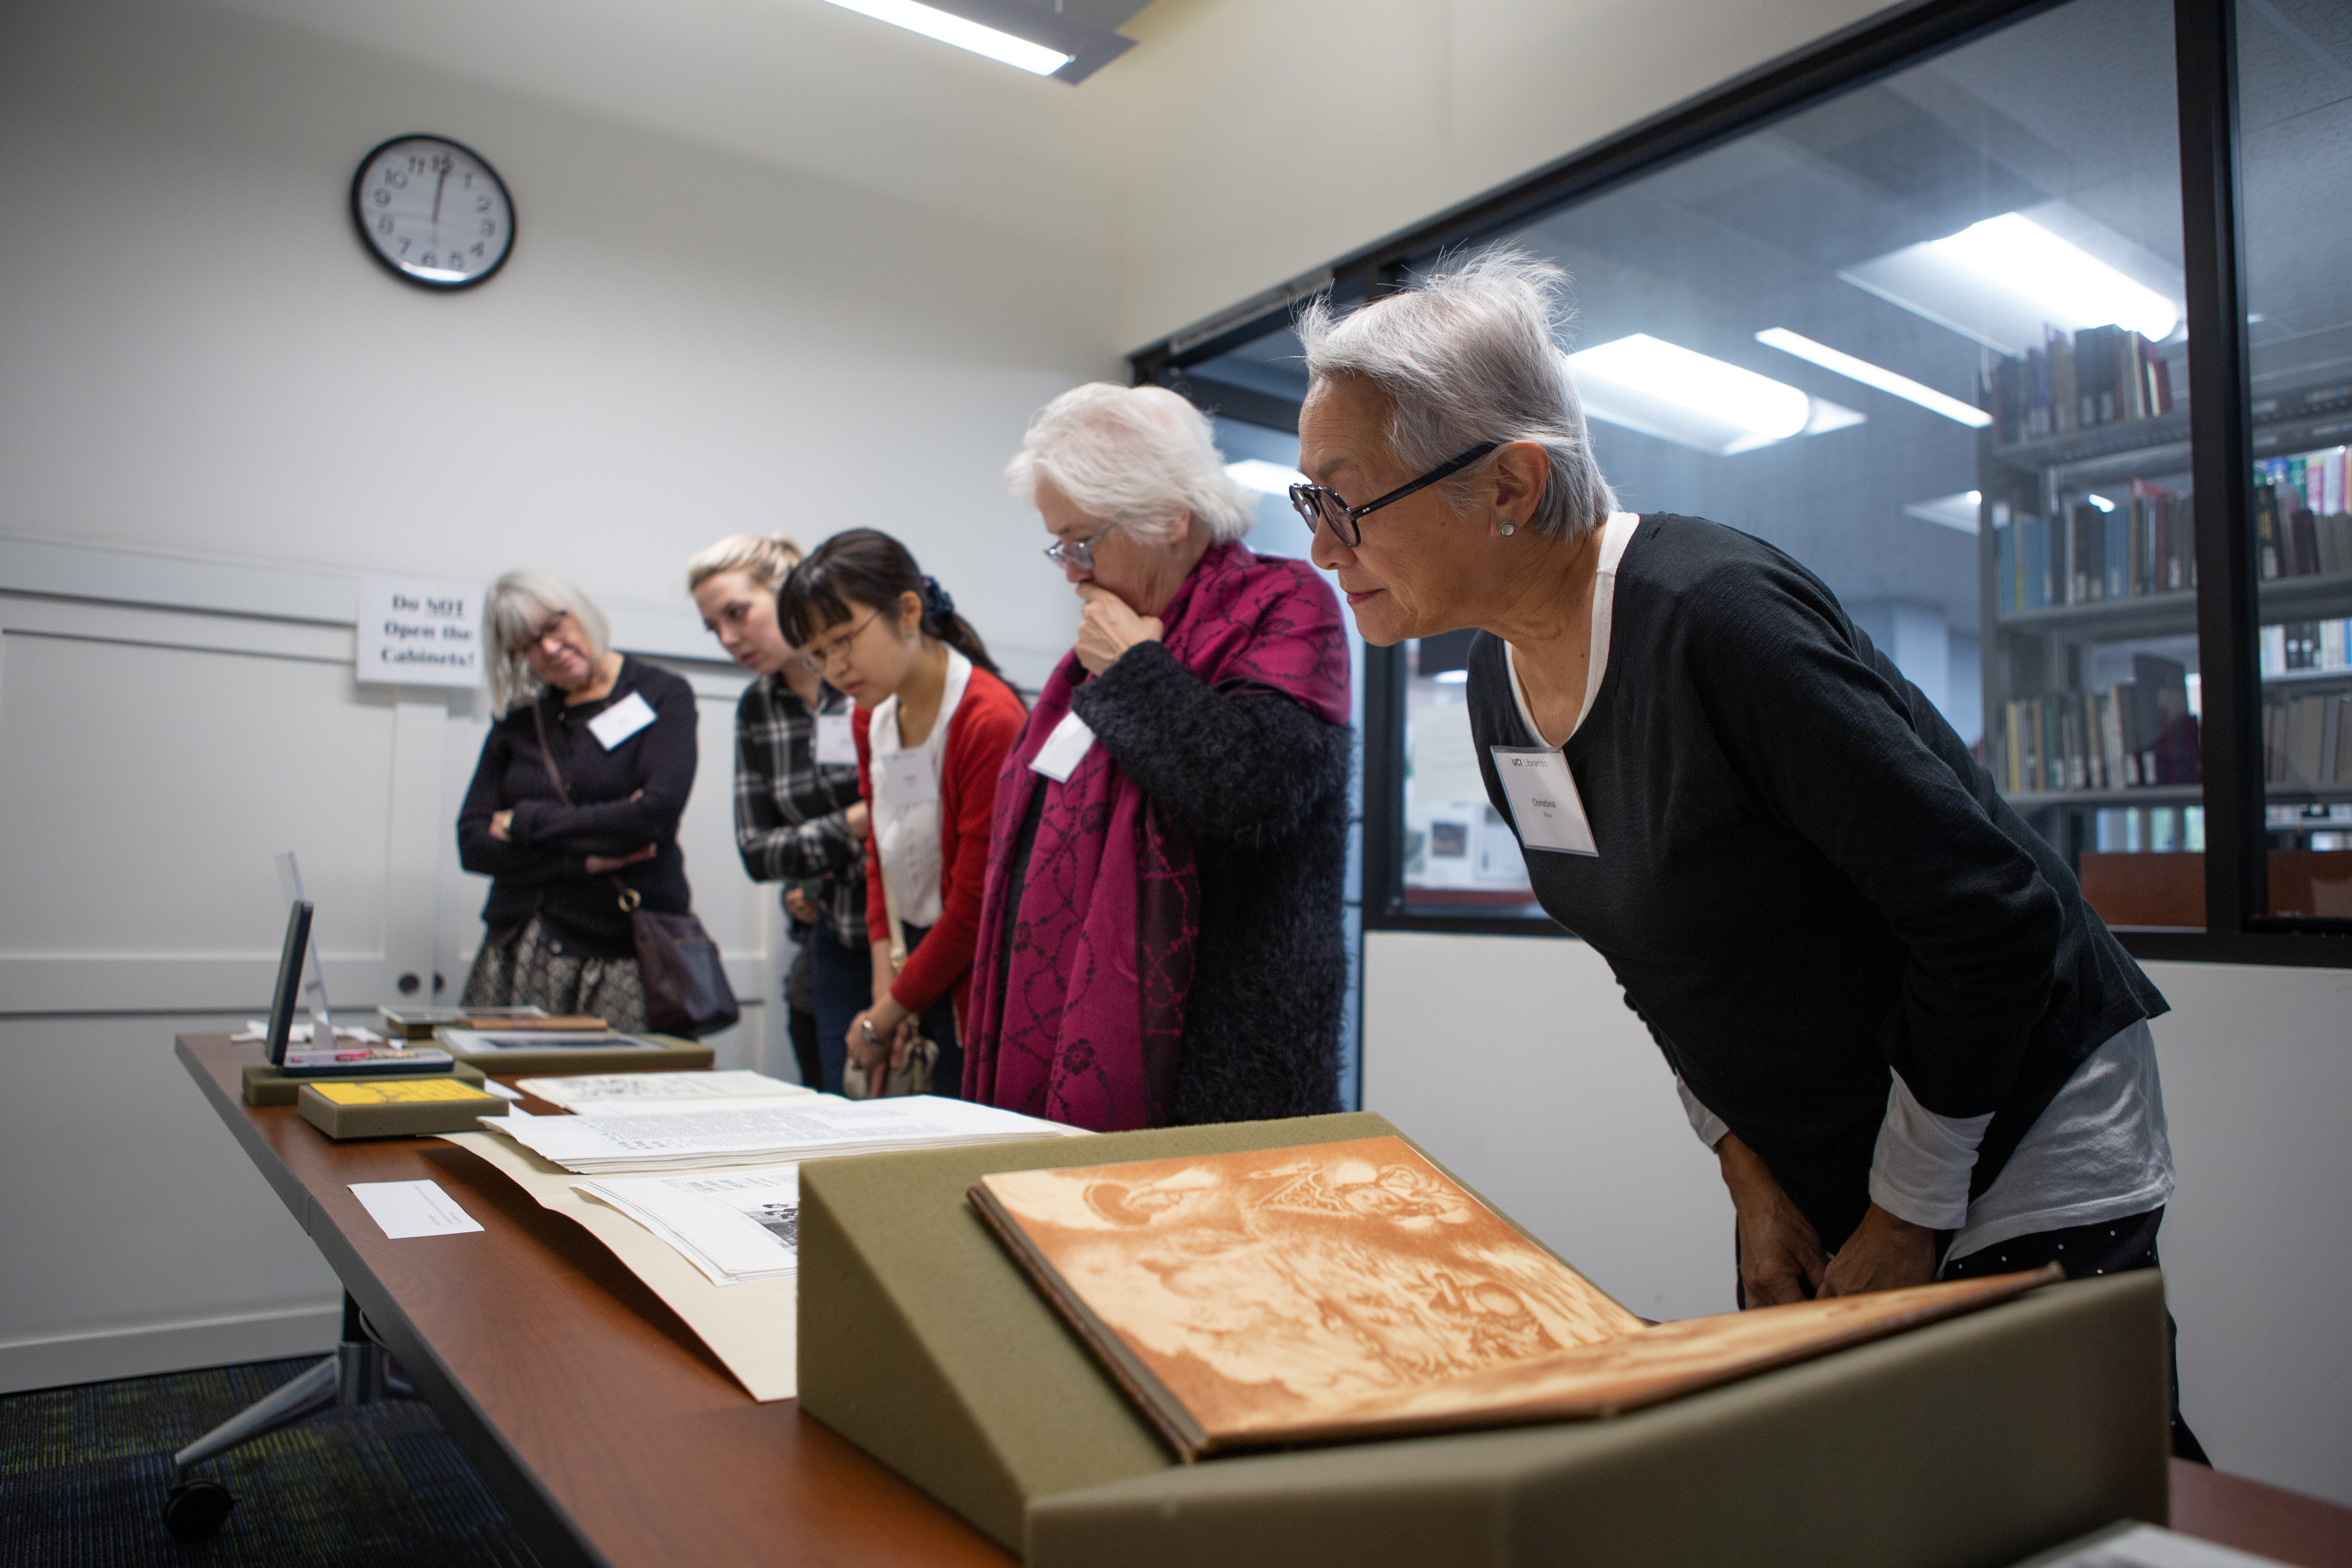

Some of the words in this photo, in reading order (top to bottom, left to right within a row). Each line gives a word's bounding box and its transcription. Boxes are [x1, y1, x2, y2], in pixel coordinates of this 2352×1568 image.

[409, 155, 425, 175] 11
[385, 167, 409, 190] 10
[465, 172, 472, 189] 1
[374, 187, 392, 208] 9
[476, 193, 493, 211] 2
[378, 214, 395, 235] 8
[478, 217, 496, 238] 3
[397, 236, 412, 256] 7
[469, 241, 485, 258] 4
[448, 250, 465, 271] 5
[393, 595, 419, 610] Do
[427, 598, 463, 616] NOT
[384, 622, 435, 639] Open
[442, 625, 470, 640] the
[381, 648, 475, 666] Cabinets!
[1511, 758, 1523, 766] UCI
[1523, 758, 1547, 767] Libraries
[1532, 798, 1556, 808] Christina
